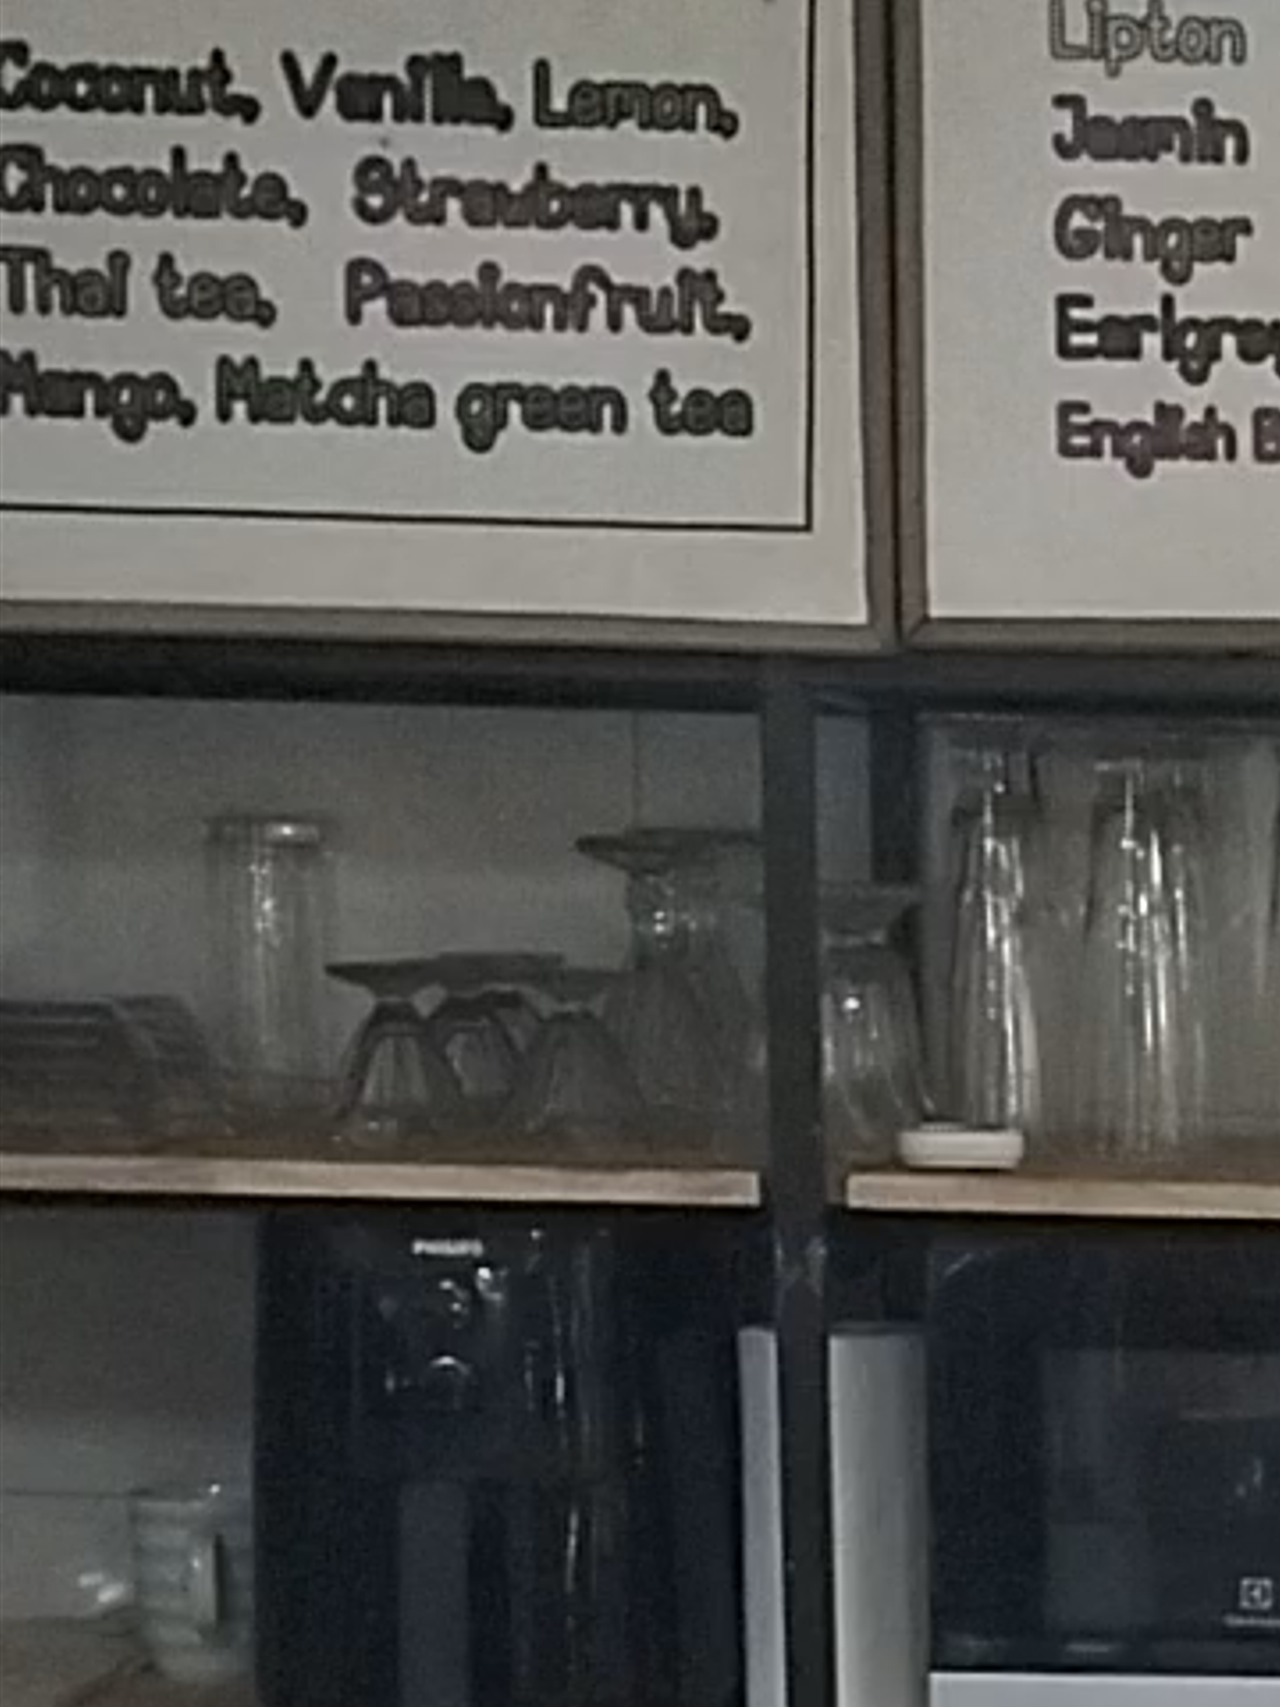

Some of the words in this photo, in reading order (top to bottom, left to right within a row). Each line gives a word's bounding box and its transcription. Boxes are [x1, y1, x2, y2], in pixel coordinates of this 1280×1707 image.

[279, 49, 515, 134] Vanilla,
[532, 57, 740, 141] Lemon,
[0, 143, 309, 230] Chocolate,
[352, 155, 720, 251] Strawberry,
[1054, 194, 1254, 287] Ginger
[152, 251, 278, 330] tea,
[344, 257, 752, 344] Passionfruit,
[215, 354, 437, 430] Matcha
[454, 382, 629, 454] green
[647, 368, 754, 438] tea
[1056, 400, 1238, 479] English
